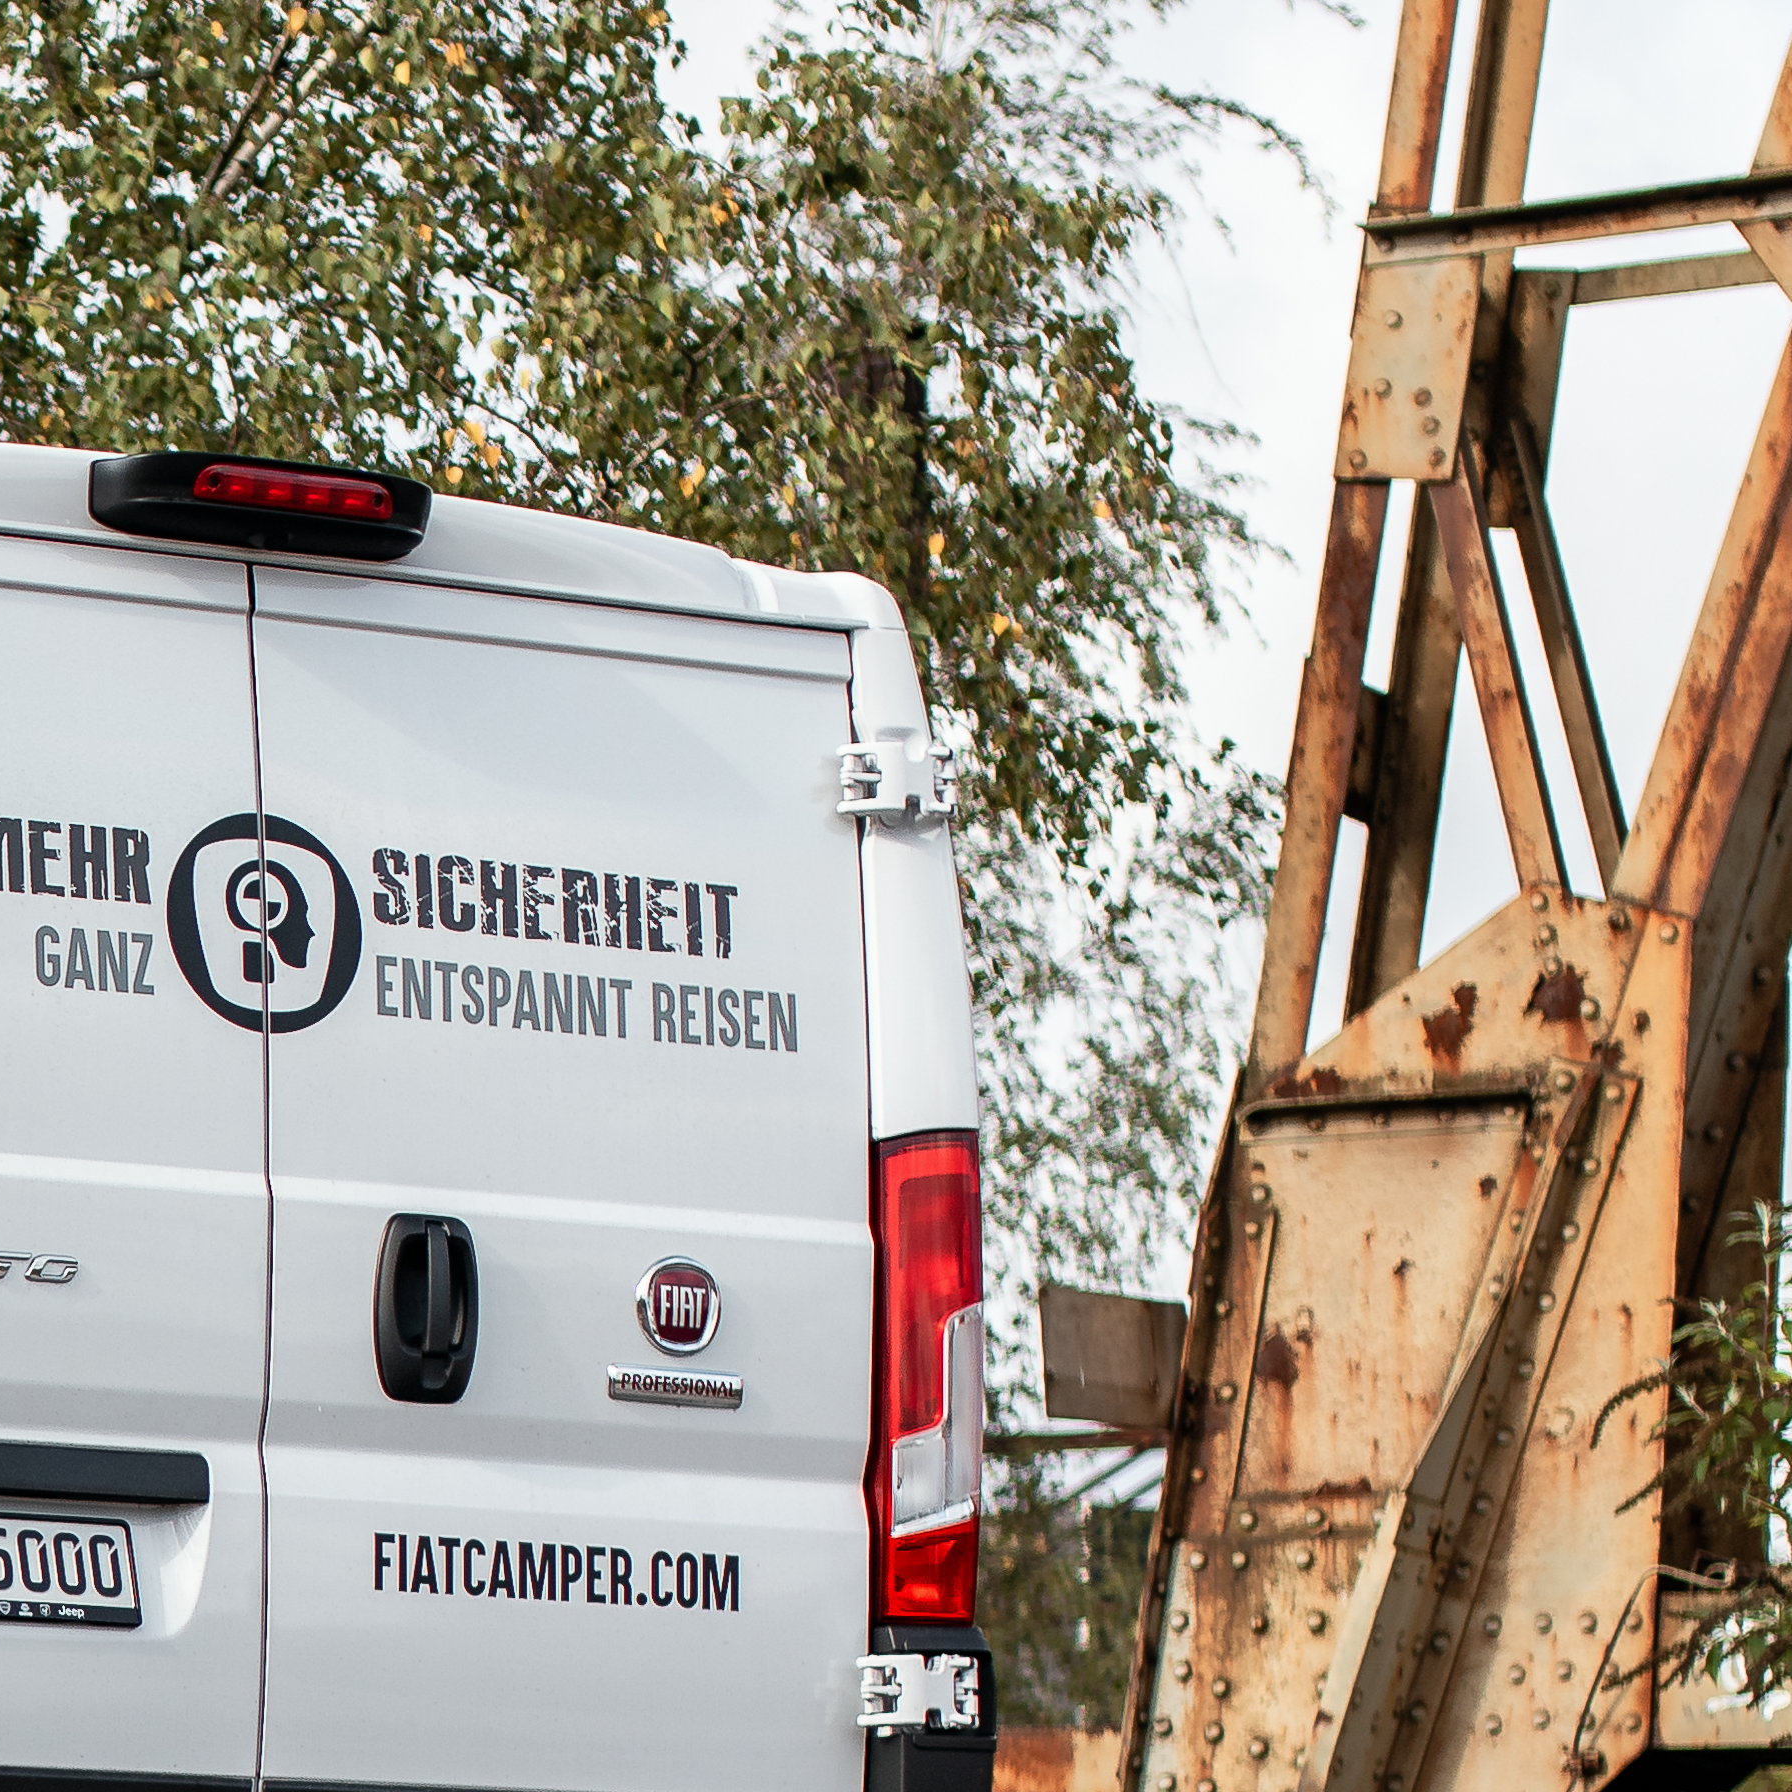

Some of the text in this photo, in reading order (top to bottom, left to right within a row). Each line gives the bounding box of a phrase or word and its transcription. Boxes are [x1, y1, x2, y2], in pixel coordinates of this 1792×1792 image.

[370, 846, 740, 961] SICHERHEIT
[35, 925, 799, 1054] GANZ ENTSPANNT REISEN
[659, 1283, 707, 1329] FIAT
[620, 1371, 737, 1399] PROFESSIONAL
[373, 1531, 740, 1613] FIATCAMPER.COM
[58, 1604, 85, 1619] Jeep
